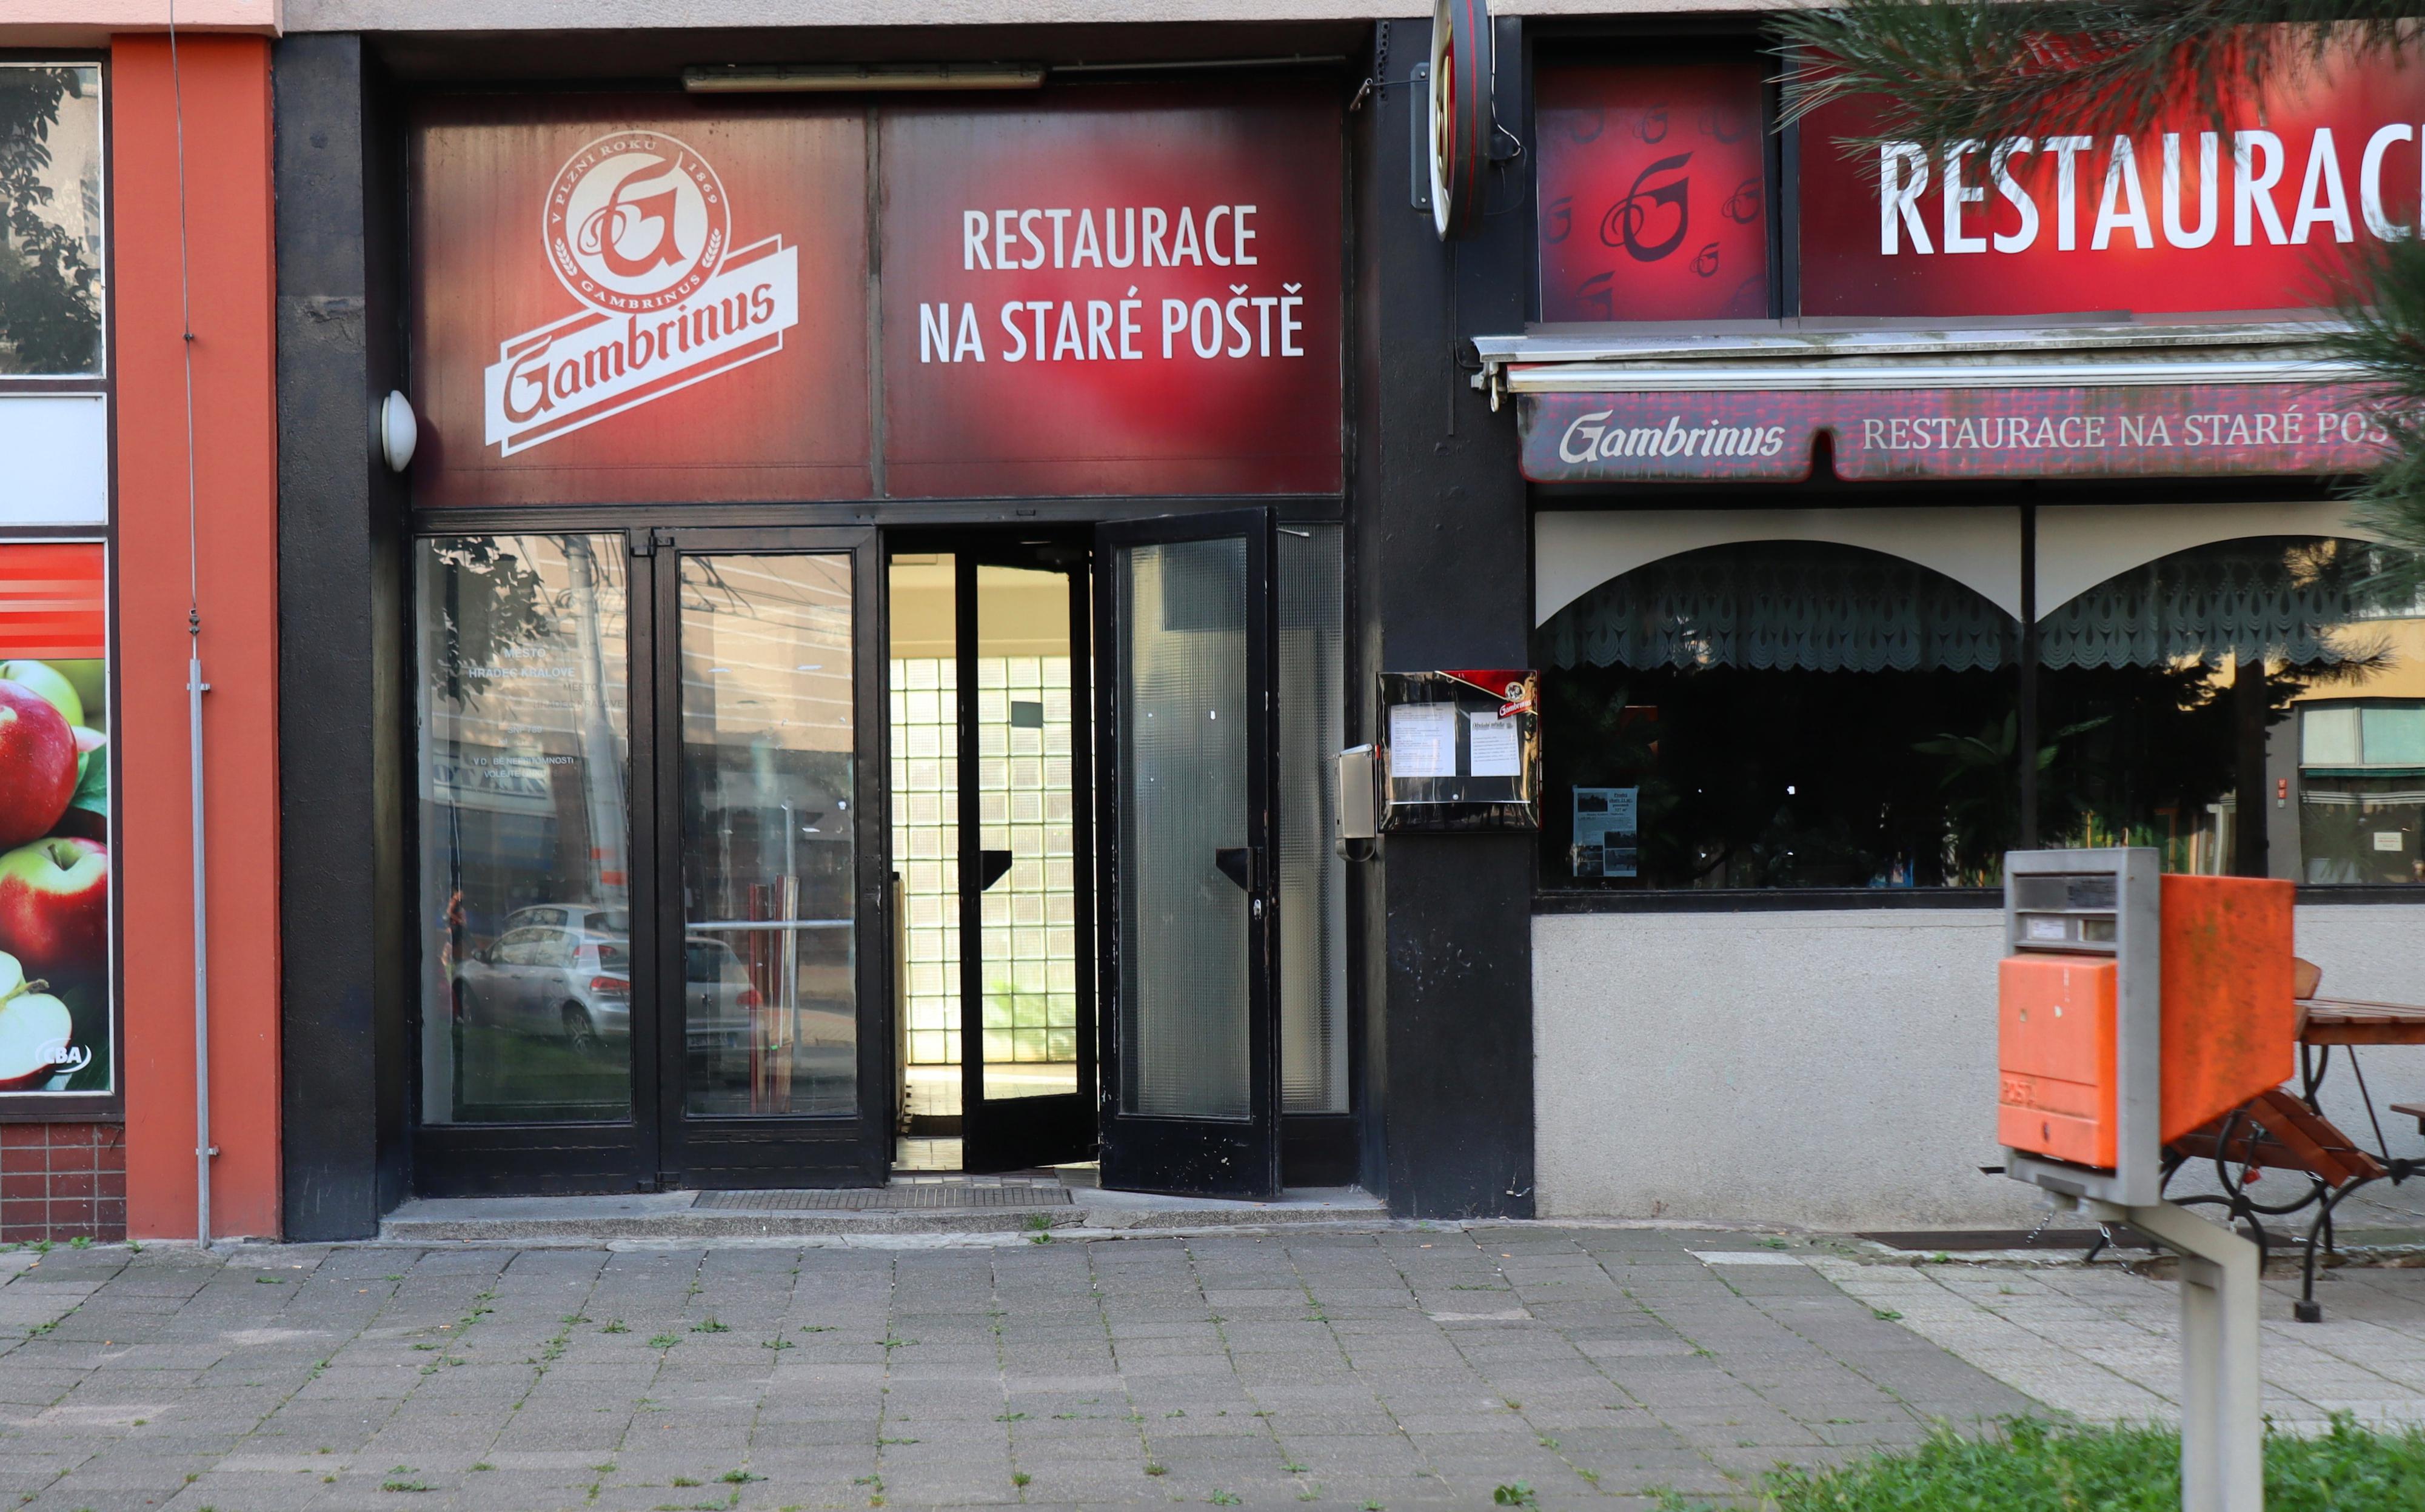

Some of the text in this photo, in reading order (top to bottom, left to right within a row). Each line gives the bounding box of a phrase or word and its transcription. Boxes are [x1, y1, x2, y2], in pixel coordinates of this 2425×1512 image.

[555, 155, 597, 206] PLZNI
[600, 139, 658, 157] ROKU
[687, 162, 718, 204] 1869
[1880, 122, 2425, 255] RESTAURAC
[963, 204, 1259, 271] RESTAURACE
[581, 274, 700, 309] GAMBRINUS
[919, 282, 1305, 363] NA STARÉ POŠTĚ
[503, 283, 775, 424] Gambrinus
[1559, 409, 1786, 464] Gambrinus
[1862, 416, 2106, 450] RESTAURACE
[2118, 415, 2173, 447] NA
[2184, 404, 2304, 445] STARÉ
[1499, 700, 1532, 717] Gambrinus
[43, 1046, 82, 1064] CBA
